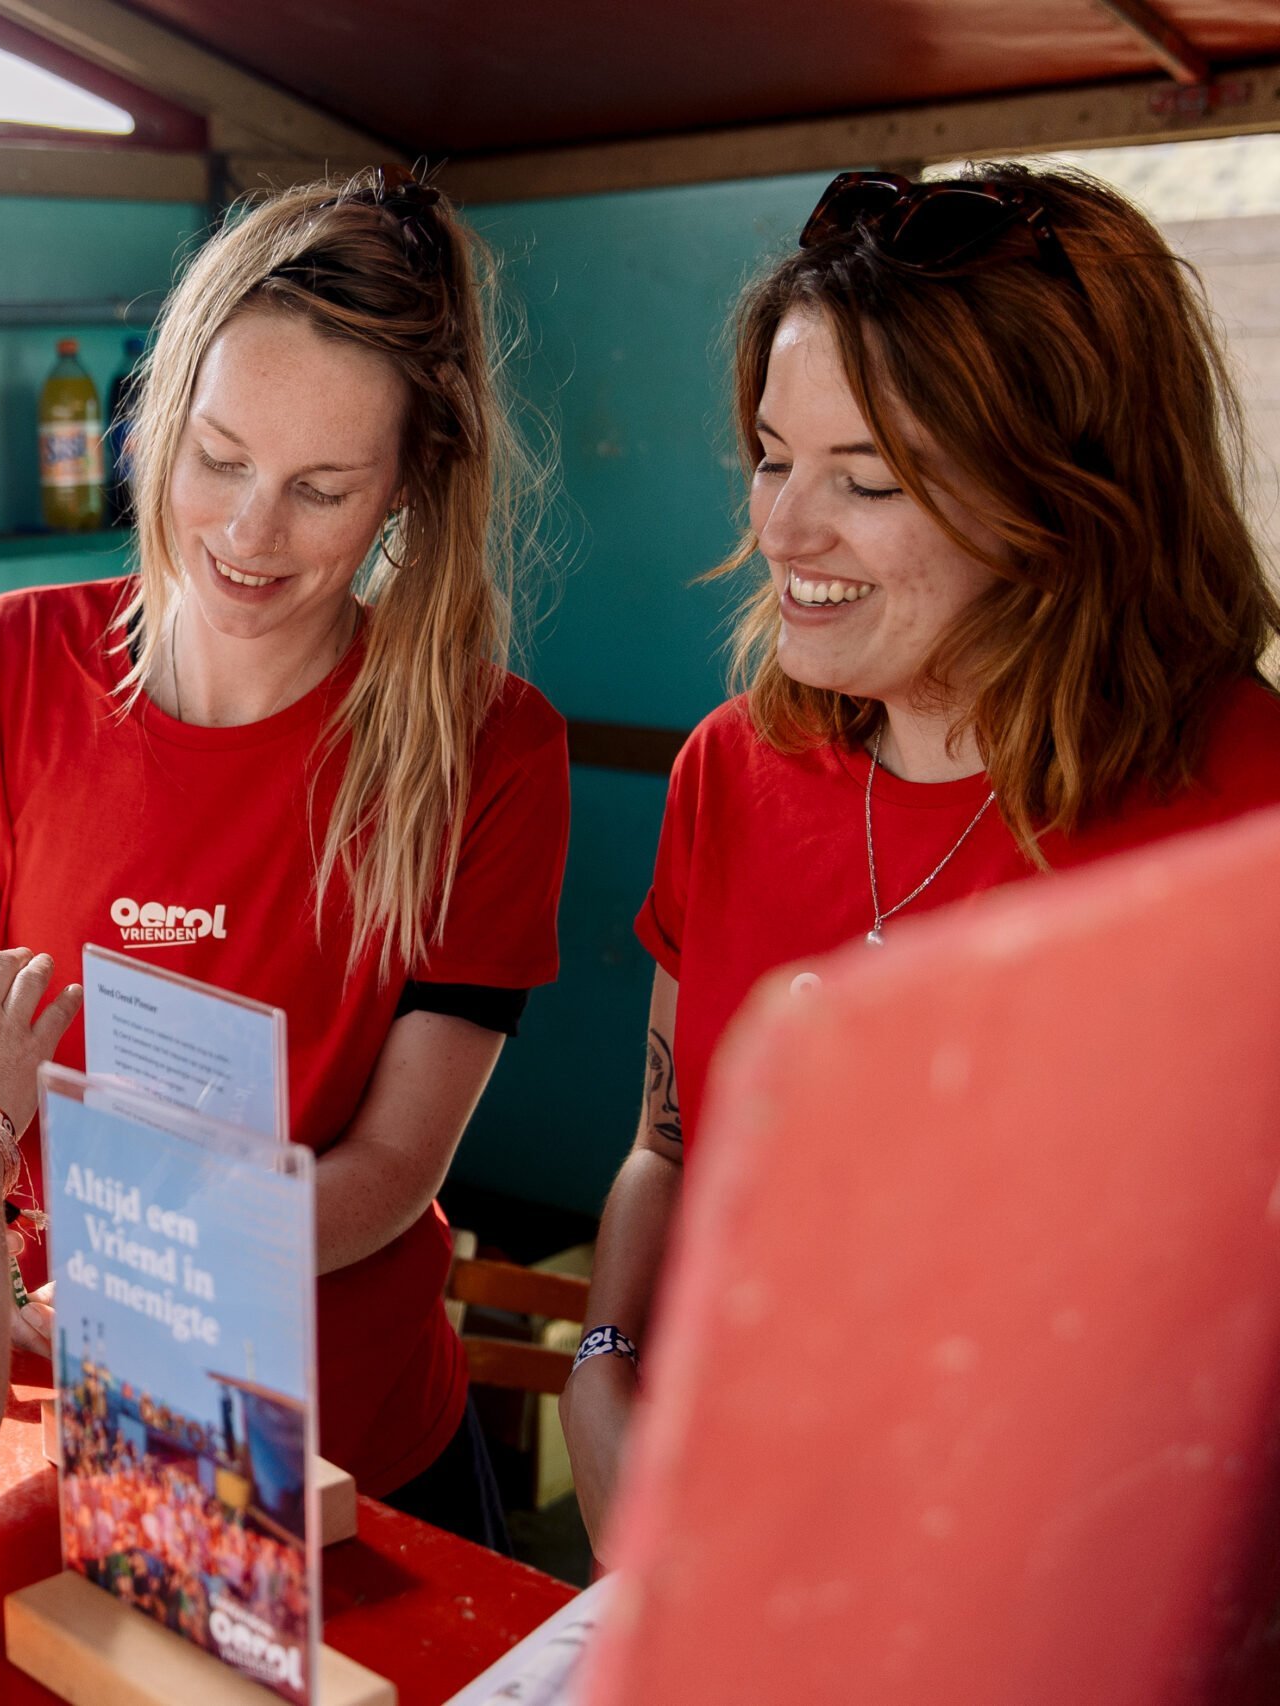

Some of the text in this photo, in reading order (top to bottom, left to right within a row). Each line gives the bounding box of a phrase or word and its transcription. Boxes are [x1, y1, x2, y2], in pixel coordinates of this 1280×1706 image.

[110, 897, 227, 939] oerol
[120, 927, 197, 941] VRIENDEN
[64, 1162, 199, 1249] Altijd een
[66, 1249, 99, 1291] de
[104, 1272, 221, 1347] menigte
[84, 1213, 177, 1285] Vriend
[183, 1255, 216, 1302] in
[208, 1609, 304, 1691] oerol
